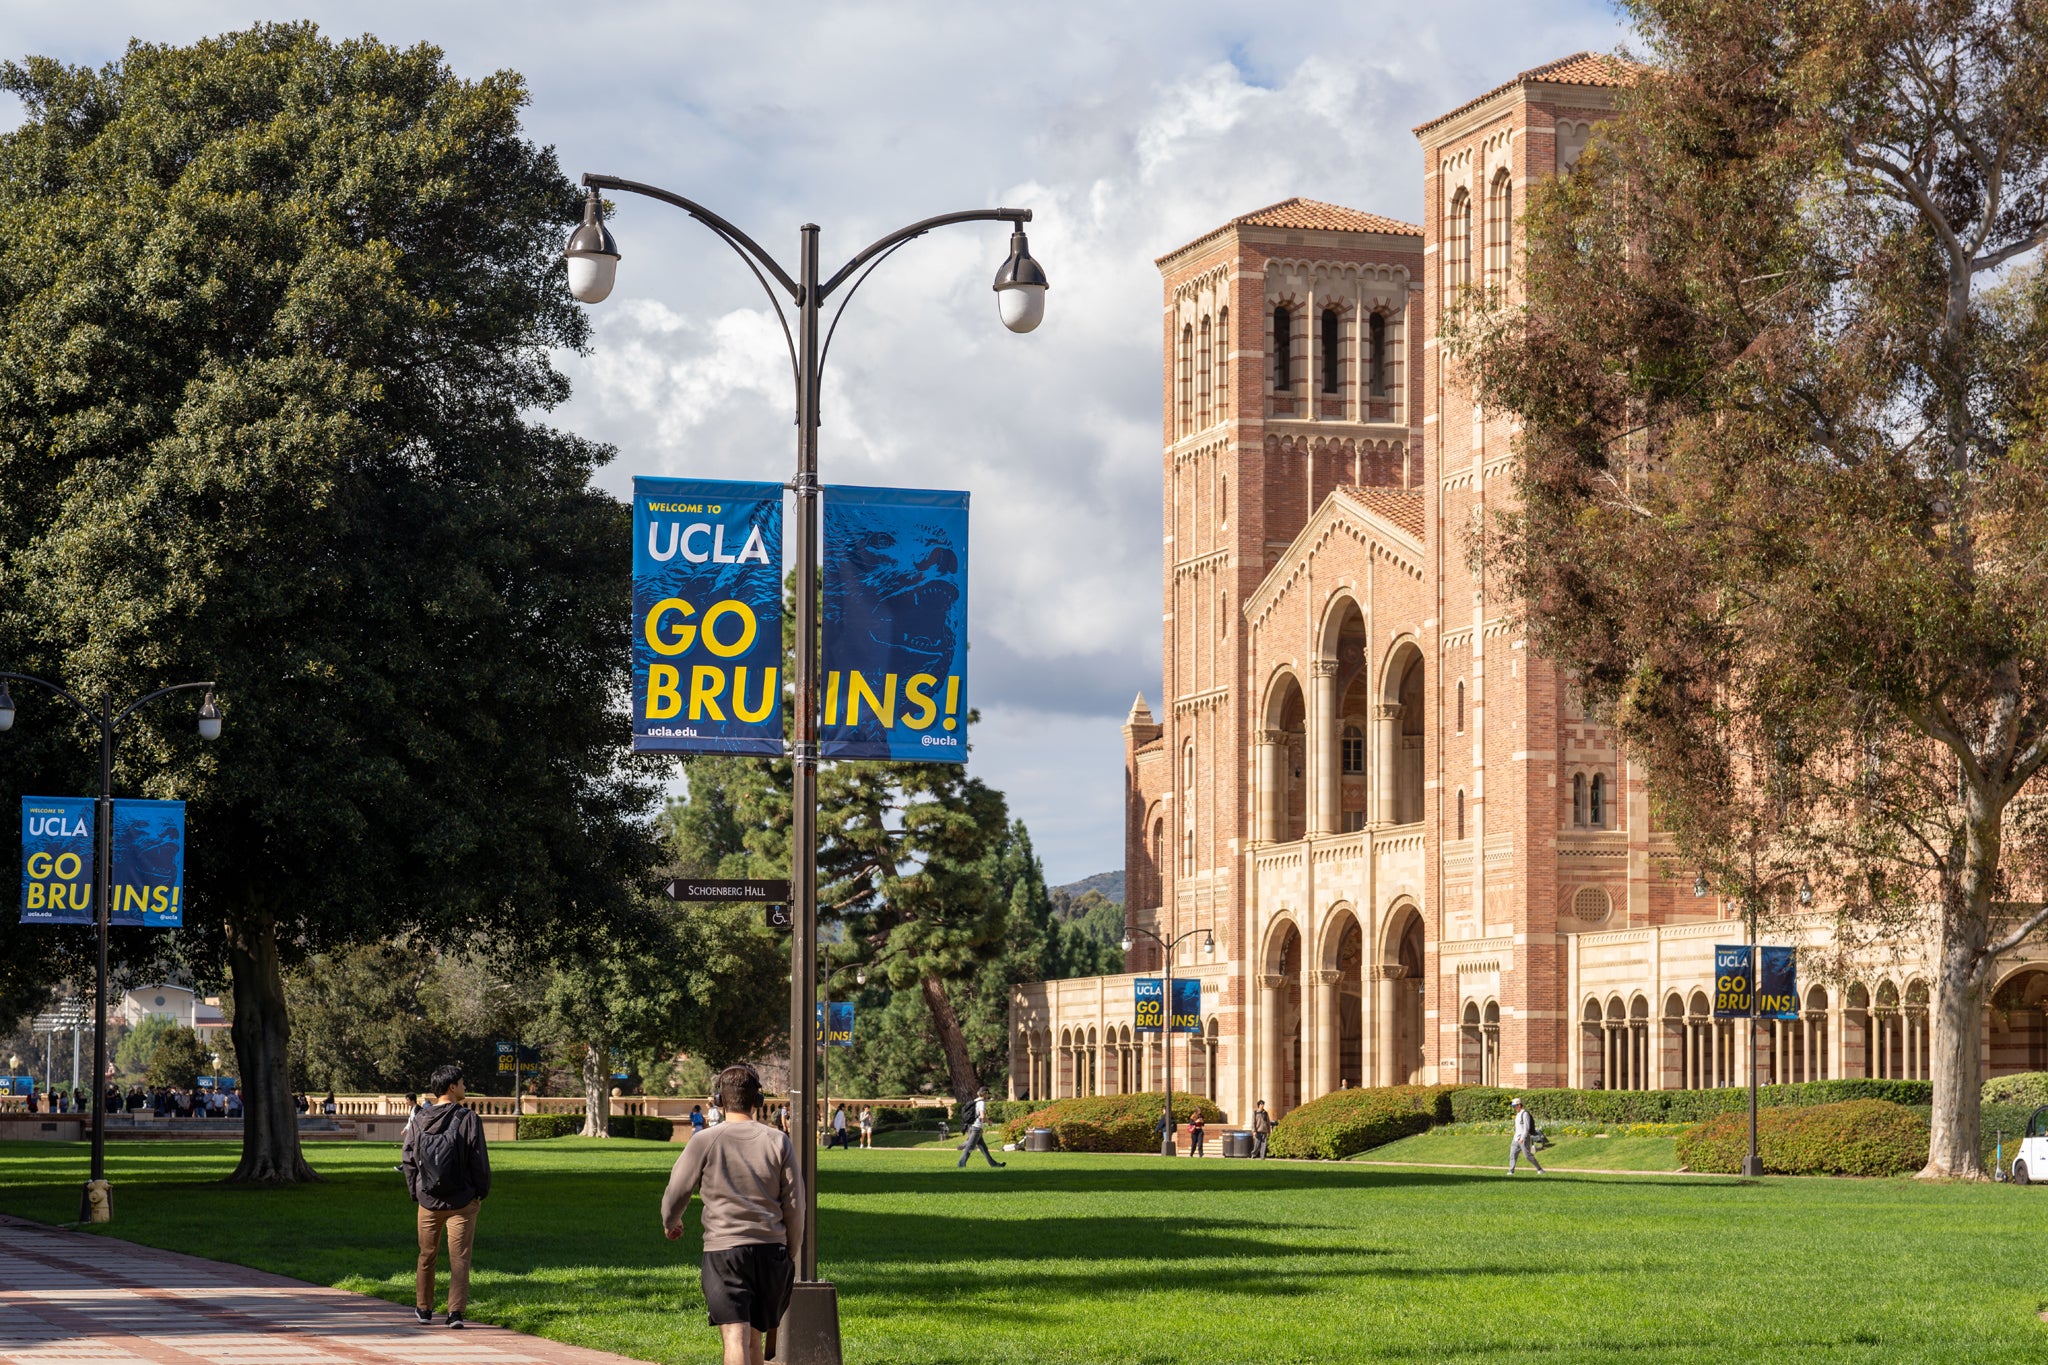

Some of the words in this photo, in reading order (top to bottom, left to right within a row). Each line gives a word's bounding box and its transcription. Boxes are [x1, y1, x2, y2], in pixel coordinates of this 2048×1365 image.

[648, 502, 703, 514] WELCOME
[707, 504, 721, 515] TO
[647, 522, 770, 565] UCLA
[645, 598, 758, 658] GO
[645, 663, 778, 723] BRU
[824, 670, 961, 732] INS!
[647, 726, 697, 737] ucla.edu
[921, 735, 957, 747] @ucla
[29, 817, 88, 837] UCLA
[27, 852, 82, 880] GO
[26, 883, 91, 911] BRU
[688, 885, 742, 896] SCHOENBERG
[744, 886, 766, 896] HALL
[112, 884, 180, 913] INS!
[1718, 956, 1749, 968] UCLA
[1717, 975, 1746, 992] GO
[1136, 986, 1162, 995] UCLA
[1136, 1001, 1160, 1014] GO
[1717, 993, 1751, 1010] BRU
[1761, 994, 1796, 1012] INS!
[1136, 1014, 1163, 1027] BRU
[1171, 1014, 1199, 1027] INS!
[829, 1030, 853, 1041] INS!
[499, 1055, 514, 1063] GO
[498, 1062, 516, 1071] BRU
